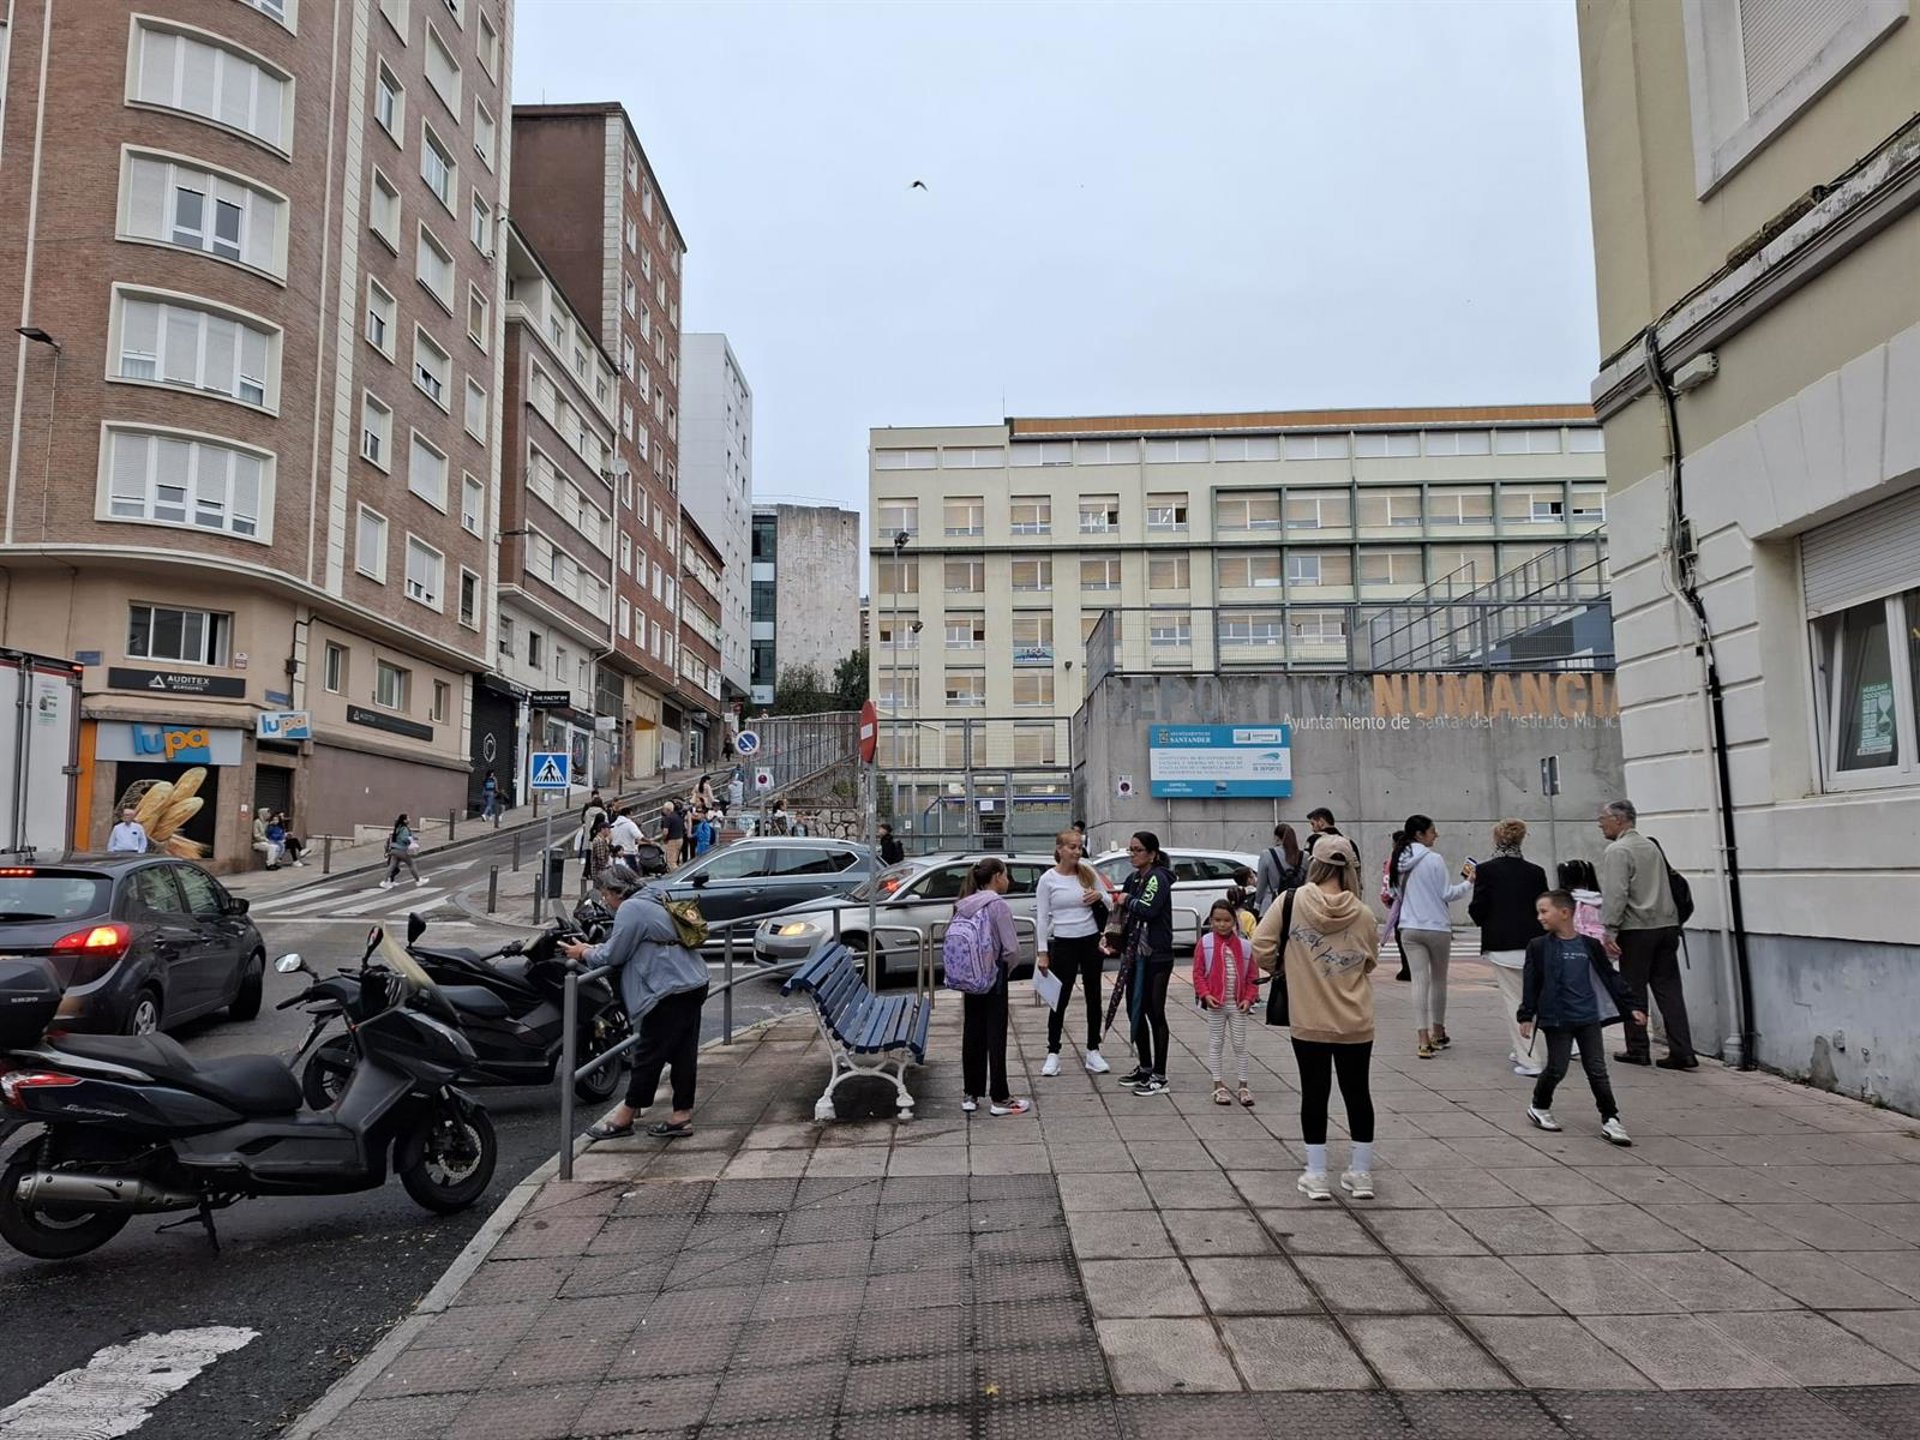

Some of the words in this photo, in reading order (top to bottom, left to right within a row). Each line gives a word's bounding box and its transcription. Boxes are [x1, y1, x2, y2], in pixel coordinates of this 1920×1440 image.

[167, 675, 210, 686] AUDITEX
[261, 714, 307, 737] lupa
[1283, 712, 1386, 735] Ayuntamiento
[1391, 712, 1410, 730] de
[1416, 711, 1494, 730] Santander
[132, 722, 209, 759] lupa
